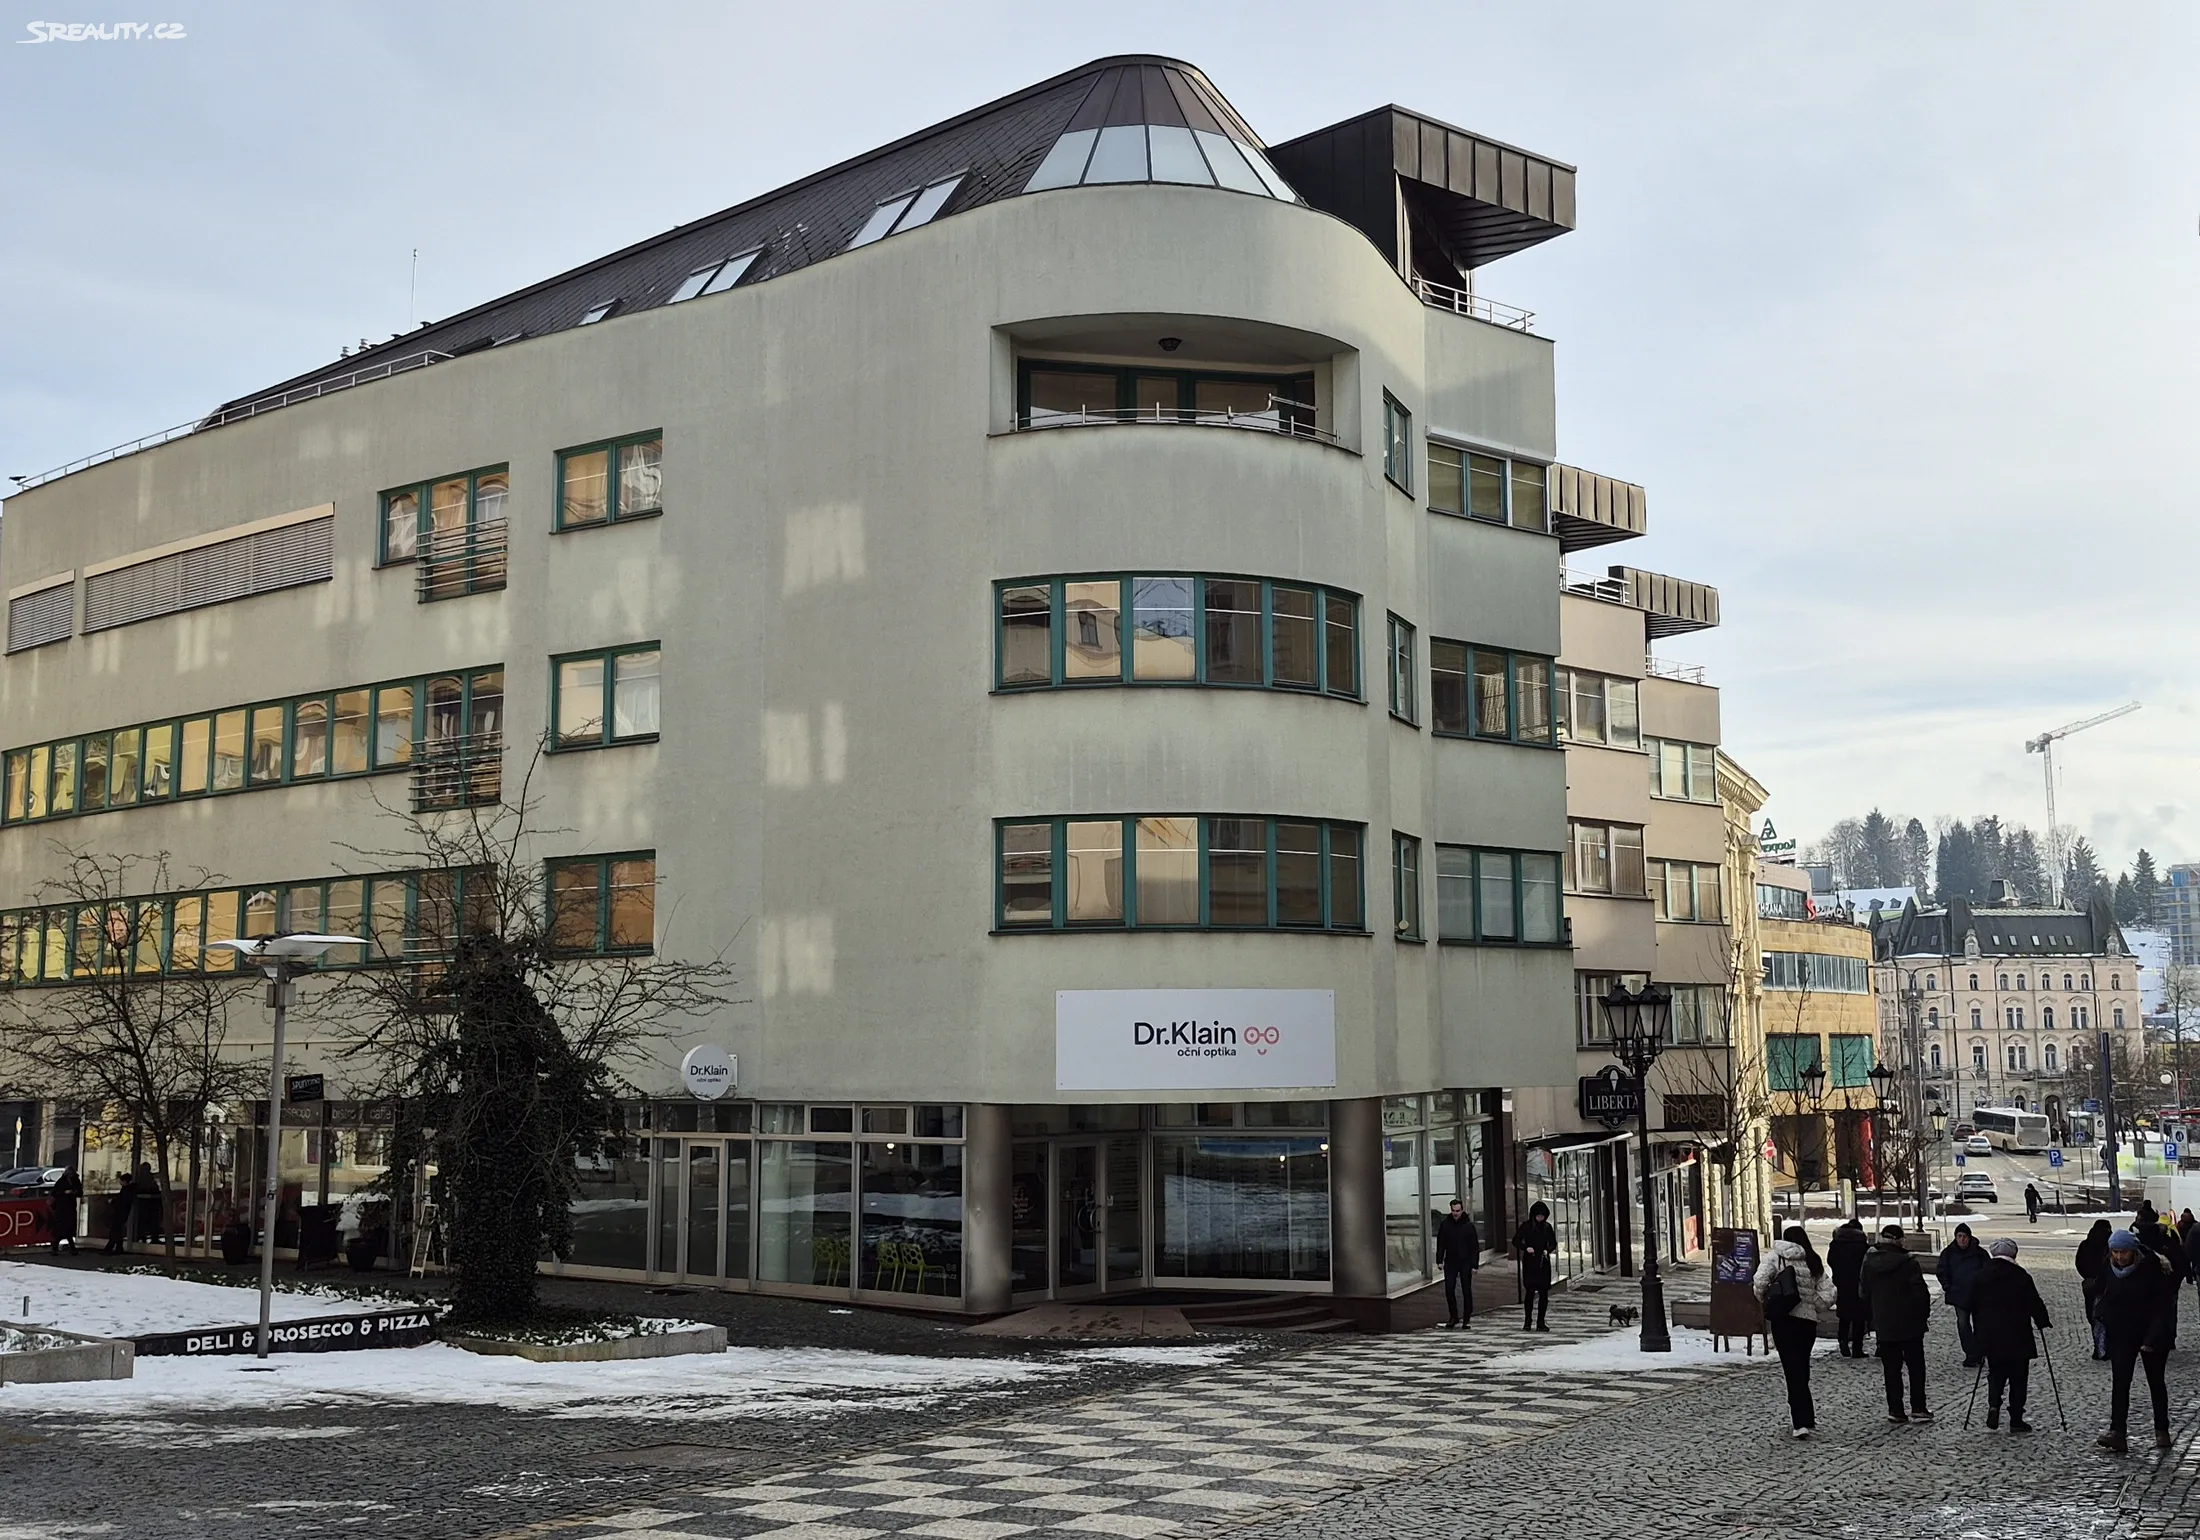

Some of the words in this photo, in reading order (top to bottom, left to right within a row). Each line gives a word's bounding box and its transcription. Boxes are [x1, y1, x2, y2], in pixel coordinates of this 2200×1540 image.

[1134, 1020, 1236, 1045] Dr.Klain
[1177, 1046, 1201, 1057] oční
[1203, 1046, 1237, 1058] optika
[690, 1064, 728, 1076] Dr.Klain
[1663, 1102, 1700, 1124] TUDIO
[187, 1333, 234, 1352] DELI
[241, 1331, 255, 1348] &
[360, 1319, 372, 1336] &
[378, 1314, 431, 1332] PIZZA
